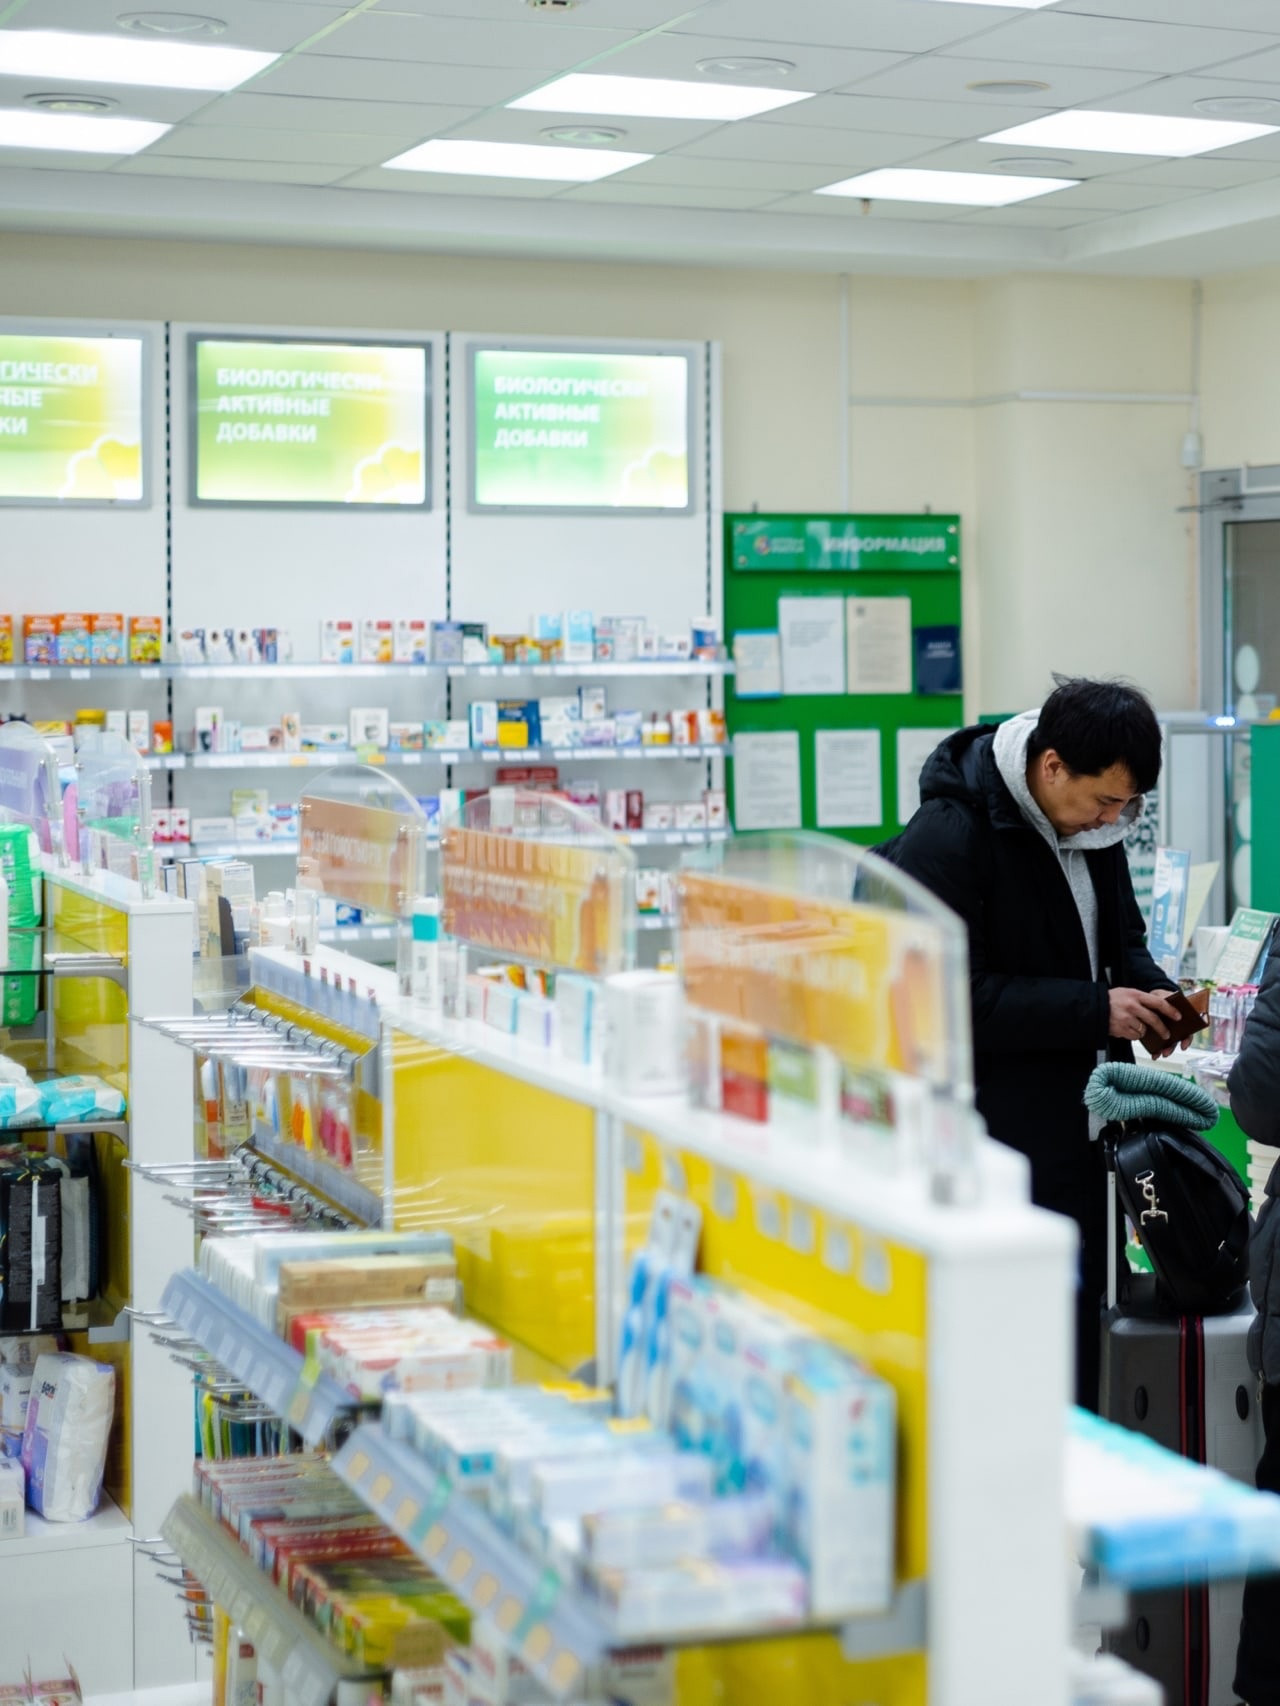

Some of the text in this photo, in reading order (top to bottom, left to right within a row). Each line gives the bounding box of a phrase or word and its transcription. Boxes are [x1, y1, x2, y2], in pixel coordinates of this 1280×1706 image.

[216, 368, 382, 390] БИОЛОГИЧЕСКИ
[216, 396, 331, 417] АКТИВНЫЕ
[495, 402, 600, 423] АКТИВНЫЕ
[216, 422, 317, 443] ДОБАВКИ
[494, 429, 588, 449] ДОБАВКИ
[823, 537, 946, 554] ИНФОРМАЦИЯ
